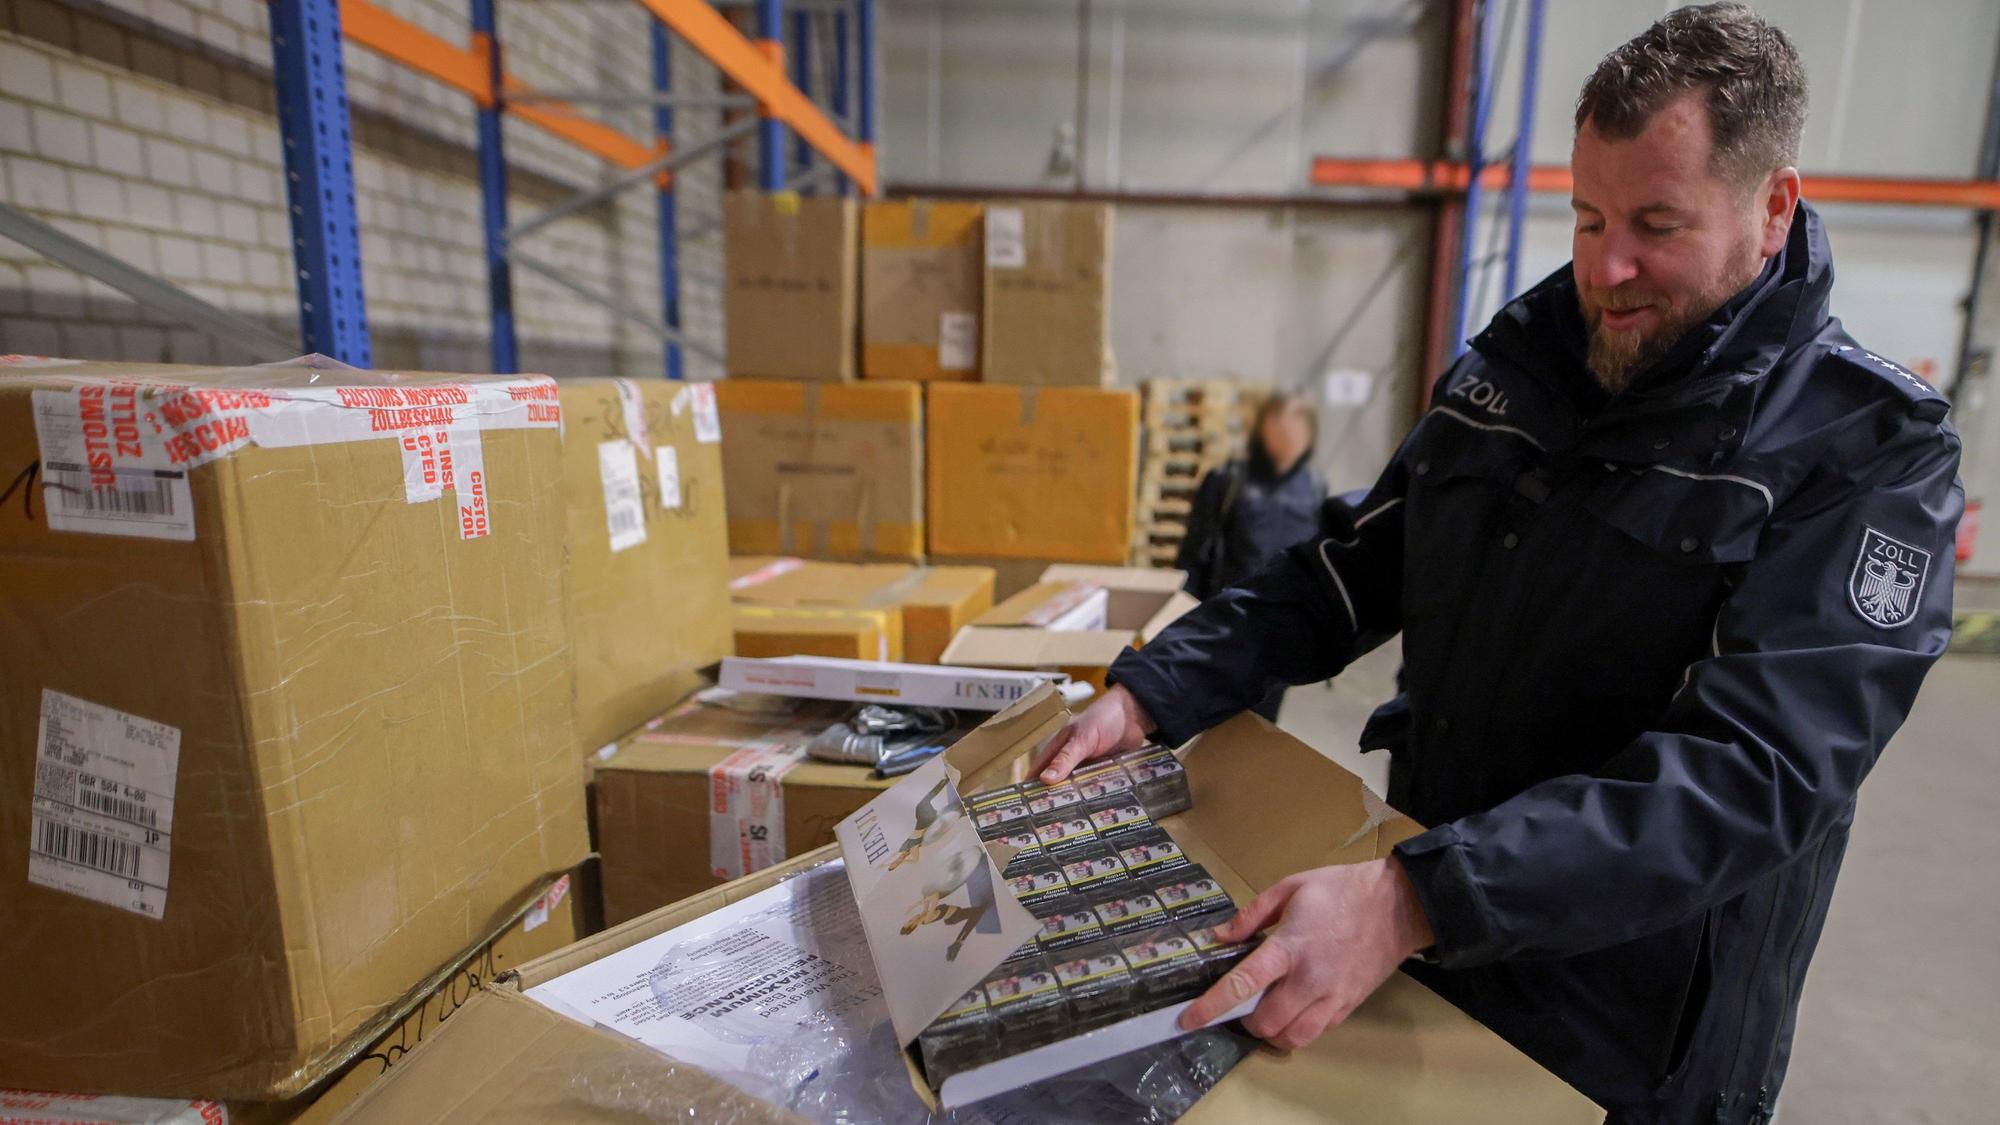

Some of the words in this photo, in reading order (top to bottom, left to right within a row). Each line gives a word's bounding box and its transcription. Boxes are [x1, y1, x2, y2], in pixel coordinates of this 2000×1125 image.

[336, 387, 404, 407] CUSTOMS
[403, 386, 468, 404] INSPECTED
[1448, 374, 1509, 415] ZOLL
[369, 408, 455, 432] ZOLLBESCHAU
[1873, 538, 1918, 569] ZOLL
[954, 680, 1024, 699] HENJI
[1126, 820, 1151, 831] Smoking
[1128, 817, 1149, 826] fertility
[854, 808, 889, 865] HENJI
[1073, 831, 1095, 841] fertility
[1104, 827, 1126, 837] reduces
[144, 831, 160, 846] 1P
[1071, 834, 1097, 845] Smoking
[1049, 841, 1072, 851] reduces
[1160, 857, 1187, 869] Smoking
[1162, 854, 1185, 865] fertility
[1103, 870, 1126, 880] fertility
[1137, 865, 1161, 875] reduces
[1101, 873, 1128, 885] Smoking
[1044, 885, 1068, 896] fertility
[1078, 881, 1102, 891] reduces
[1042, 888, 1069, 900] Smoking
[1073, 929, 1103, 942] Smoking
[1047, 937, 1074, 948] reduces
[782, 963, 846, 993] Exercise
[677, 953, 821, 1020] PERFORMANCE
[707, 969, 811, 1017] MAXIMUM
[754, 981, 834, 1018] Weighted
